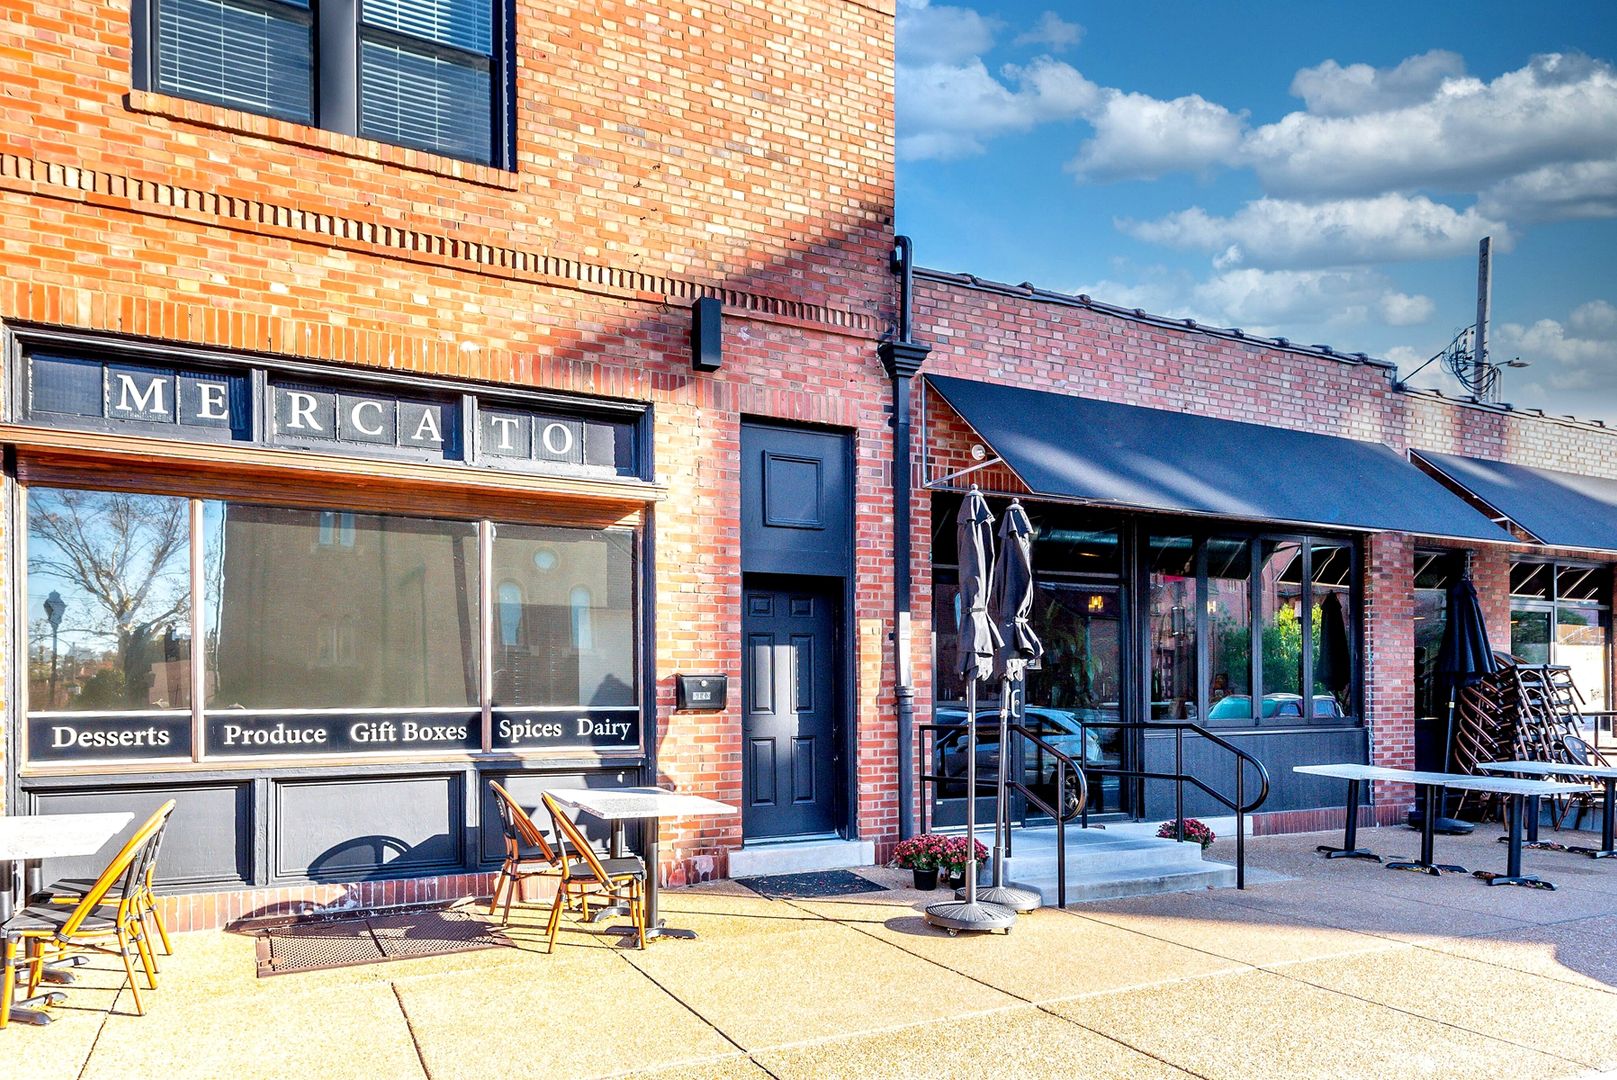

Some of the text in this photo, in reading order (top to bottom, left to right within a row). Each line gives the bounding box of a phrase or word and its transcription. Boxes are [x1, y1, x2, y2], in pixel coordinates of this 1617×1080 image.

[115, 373, 574, 456] MERCATO
[52, 718, 631, 747] Desserts Produce Gift Boxes Spices Dairy
